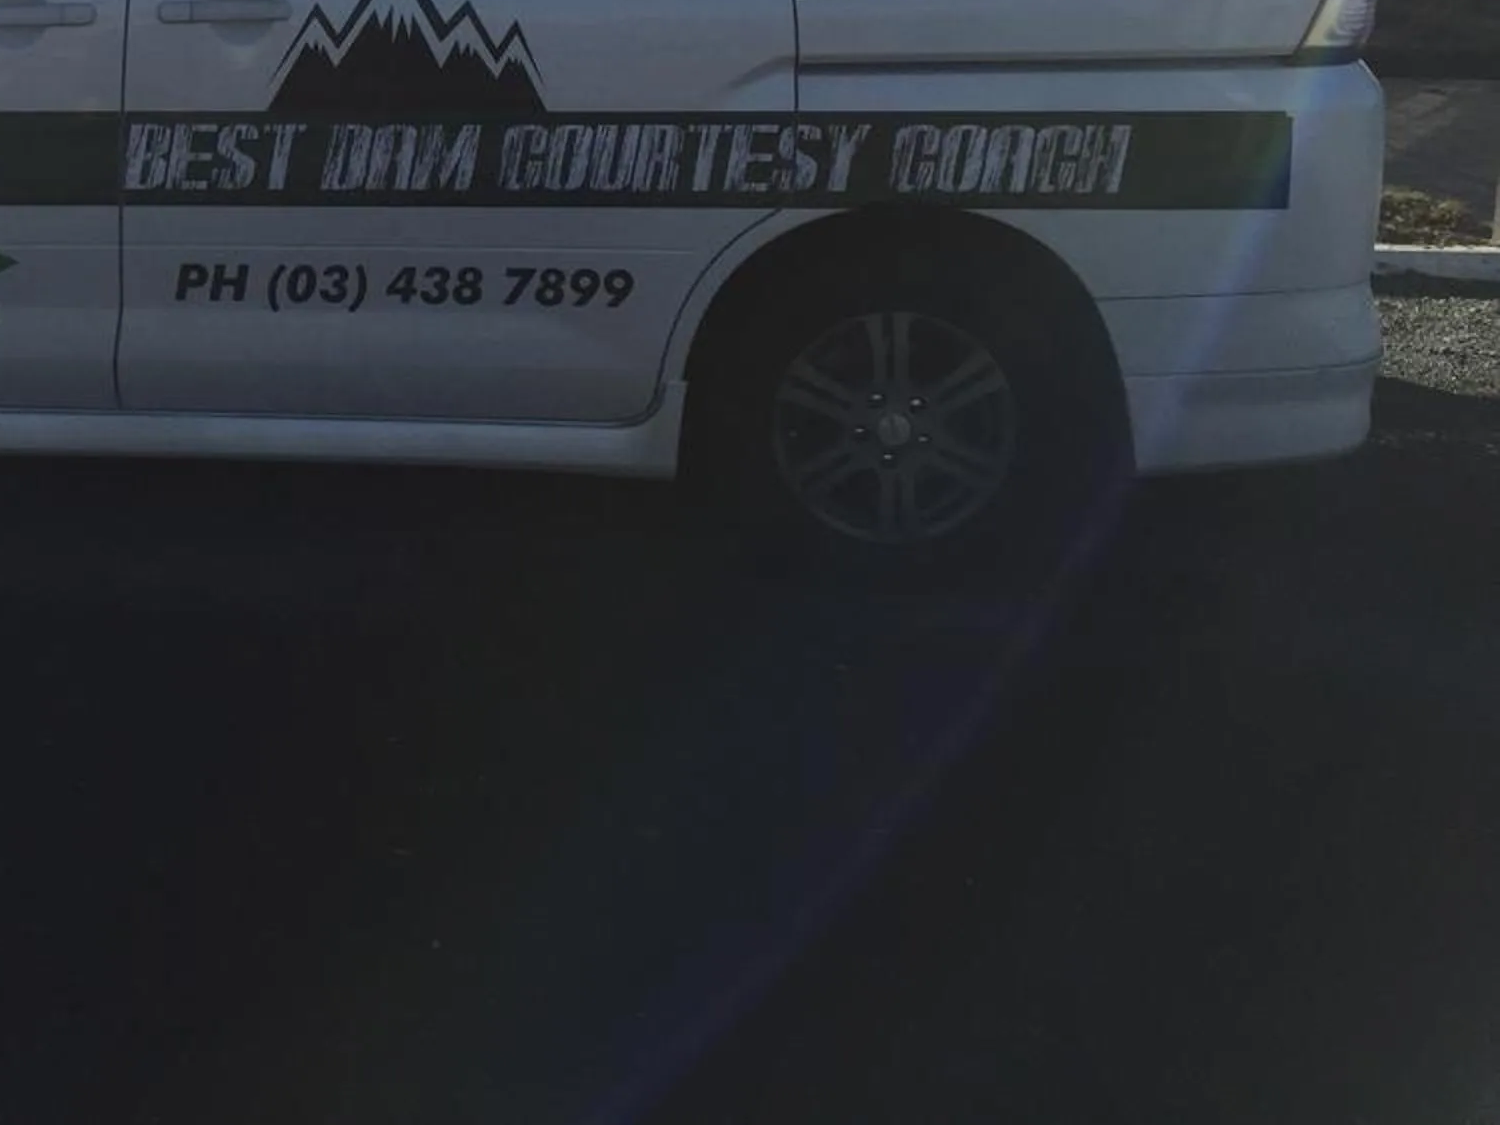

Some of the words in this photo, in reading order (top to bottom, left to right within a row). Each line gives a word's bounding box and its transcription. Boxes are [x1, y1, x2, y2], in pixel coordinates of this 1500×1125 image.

[121, 122, 307, 191] BEST
[320, 122, 482, 192] DAM
[499, 123, 872, 193] COURTESY
[889, 123, 1132, 195] COACH
[175, 263, 250, 302] PH
[267, 263, 369, 312] (03)
[386, 266, 483, 305] 438
[503, 267, 635, 308] 7899
